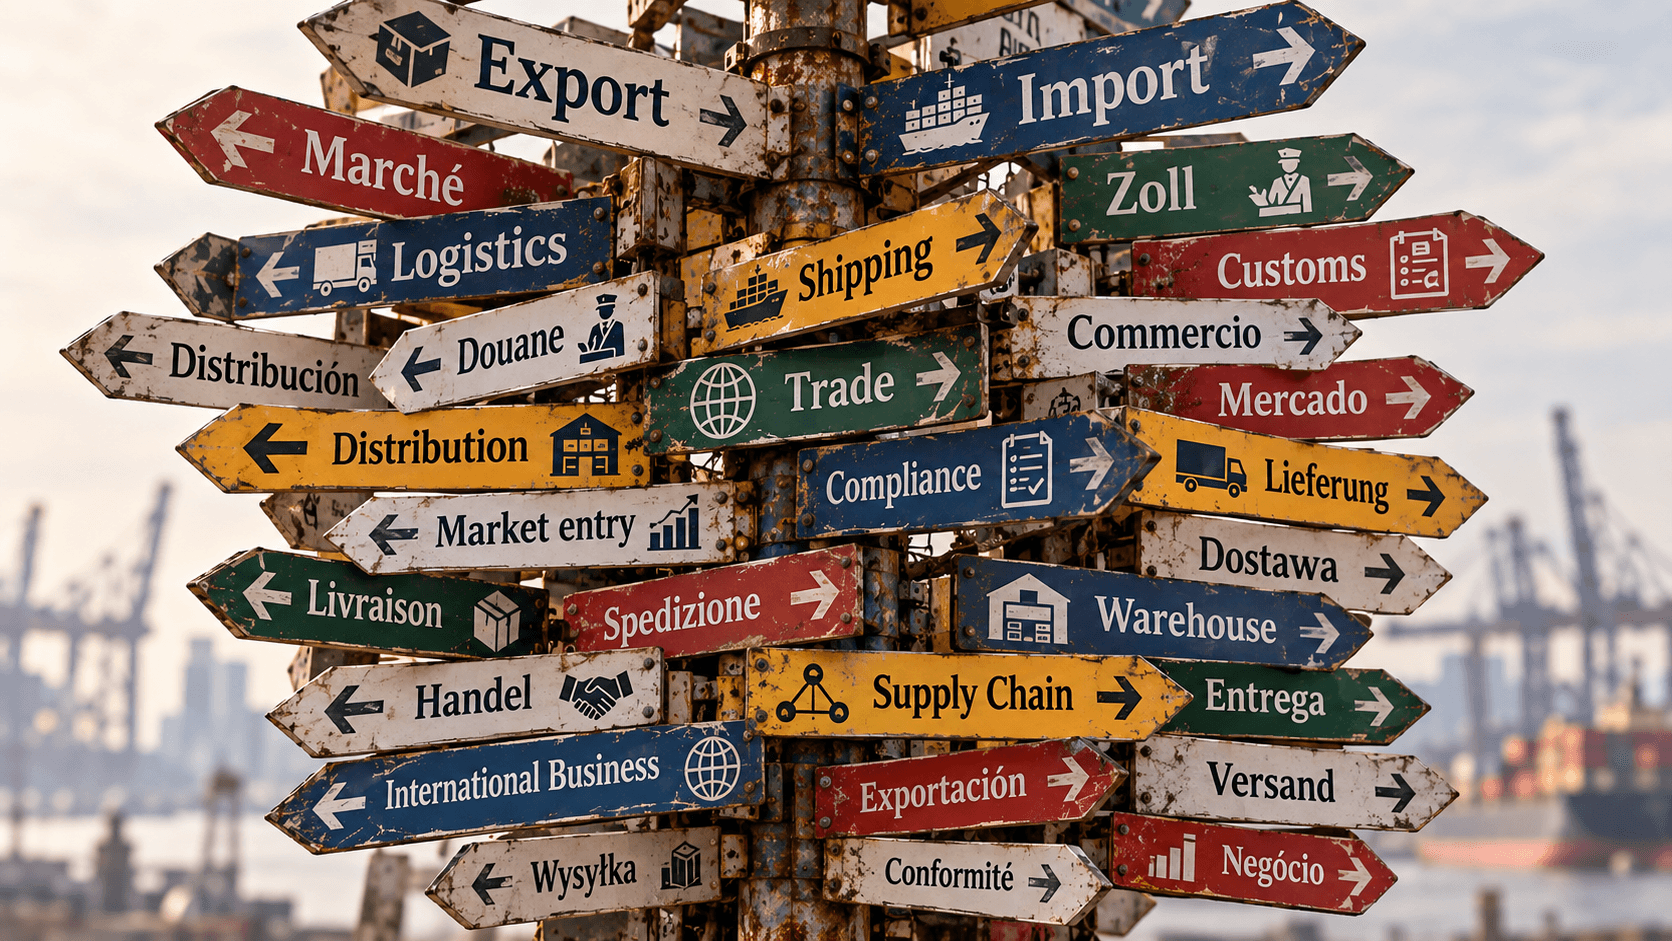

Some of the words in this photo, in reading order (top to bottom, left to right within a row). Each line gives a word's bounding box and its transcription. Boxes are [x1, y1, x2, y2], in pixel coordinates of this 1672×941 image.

[473, 32, 671, 127] Export
[1018, 27, 1210, 127] Import
[301, 128, 465, 206] Marché
[1105, 165, 1198, 216] Zoll
[391, 227, 568, 288] Logistics
[798, 236, 934, 300] Shipping
[1217, 251, 1367, 290] Customs
[456, 322, 564, 375] Douane
[1066, 314, 1262, 351] Commercio
[169, 342, 361, 398] Distribución
[785, 362, 895, 413] Trade
[1218, 380, 1368, 417] Mercado
[332, 428, 529, 465] Distribution
[825, 460, 982, 510] Compliance
[1264, 458, 1390, 514] Lieferung
[436, 511, 550, 549] Market
[559, 510, 636, 548] entry
[1199, 536, 1339, 583] Dostawa
[306, 579, 443, 629] Livraison
[602, 591, 762, 648] Spedizione
[1095, 595, 1278, 644] Warehouse
[415, 674, 532, 720] Handel
[873, 674, 978, 720] Supply
[985, 674, 1074, 711] Chain
[1204, 678, 1326, 723] Entrega
[384, 759, 540, 811] International
[548, 753, 660, 791] Business
[860, 765, 1026, 818] Exportación
[1207, 761, 1335, 803] Versand
[530, 853, 637, 900] Wysyłka
[884, 857, 1014, 892] Conformité
[1221, 843, 1325, 888] Negócio
